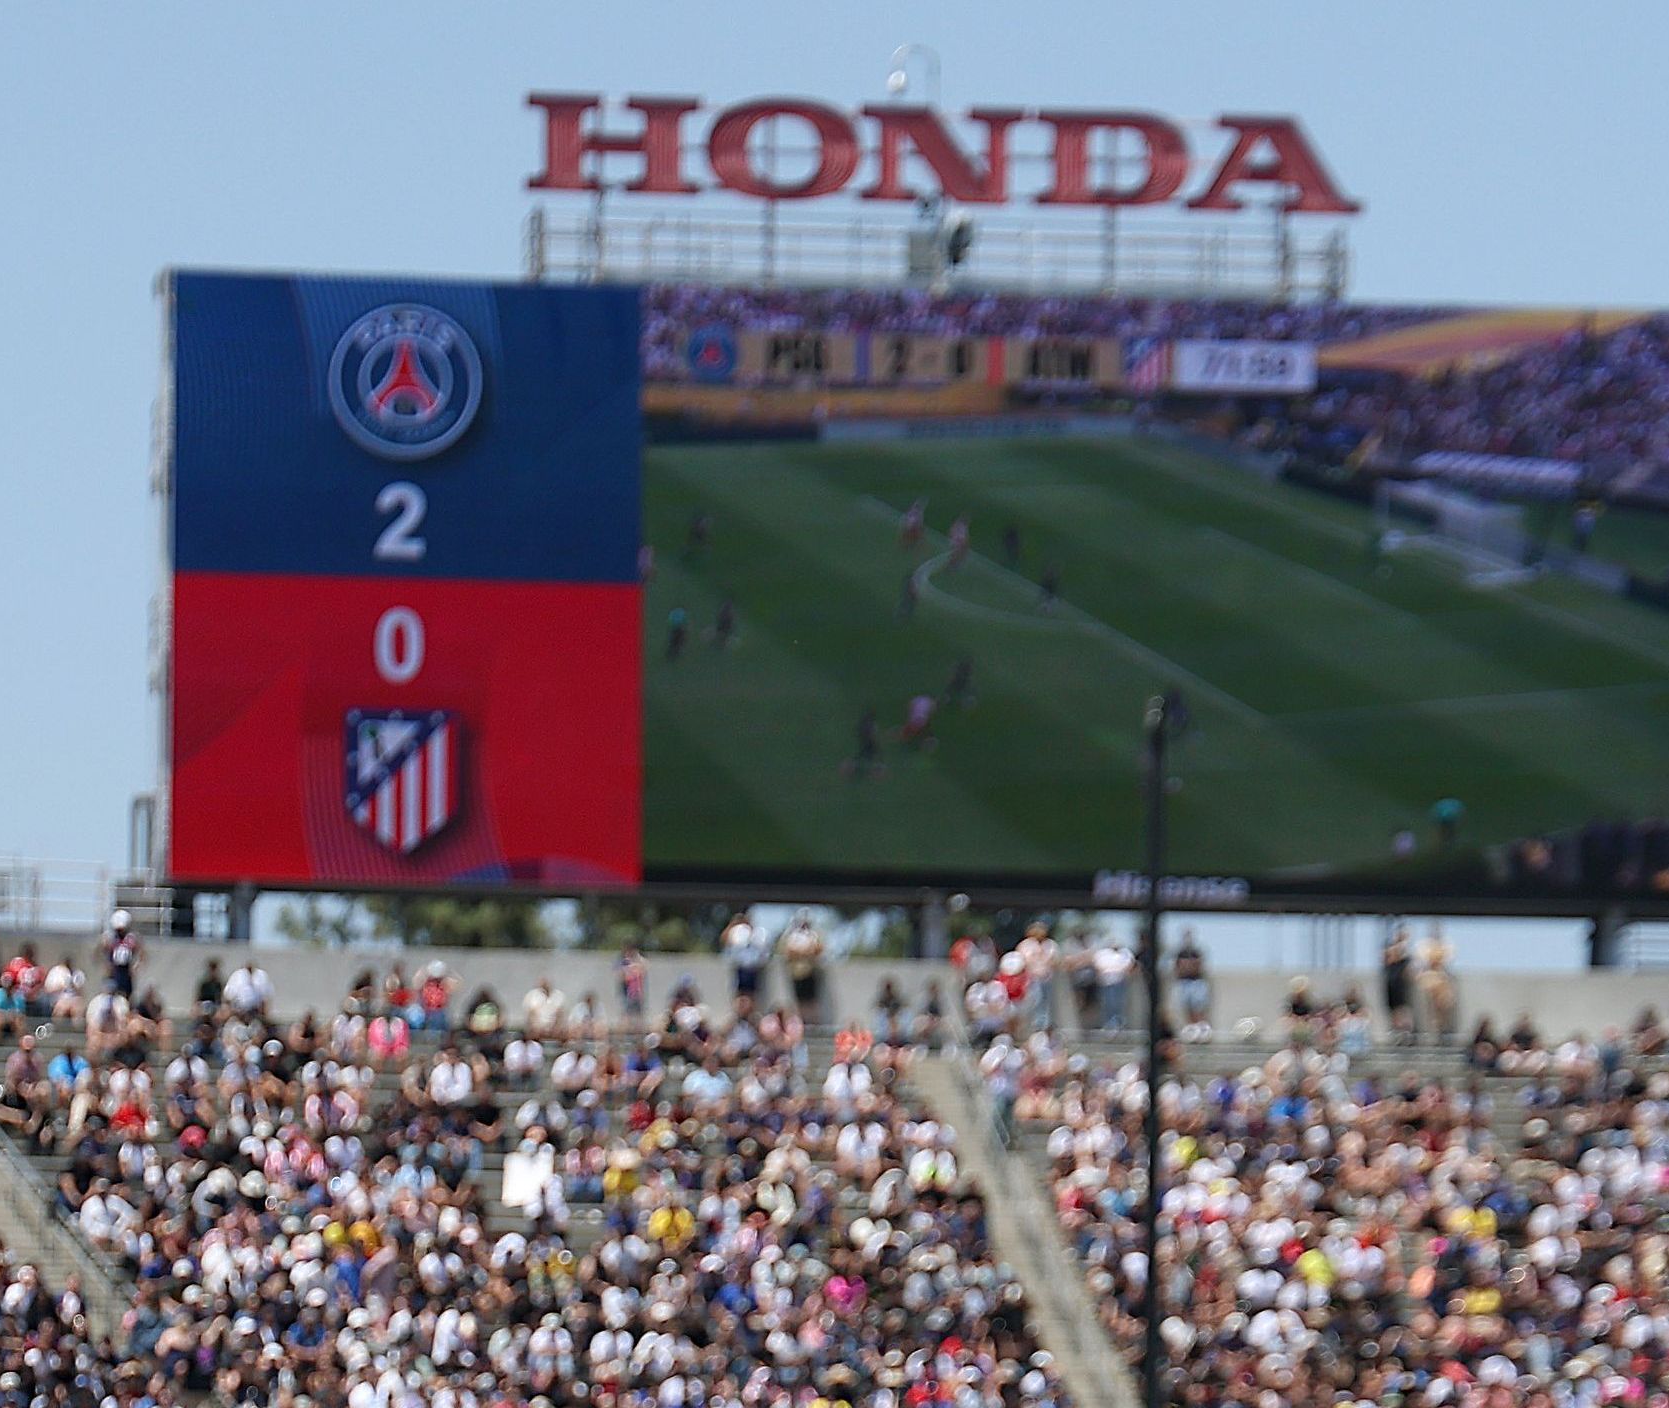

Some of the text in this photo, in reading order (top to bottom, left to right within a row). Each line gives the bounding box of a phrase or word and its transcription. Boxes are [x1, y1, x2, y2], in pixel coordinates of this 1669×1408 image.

[526, 90, 1361, 214] HONDA
[373, 482, 428, 561] 2
[373, 605, 426, 684] 0
